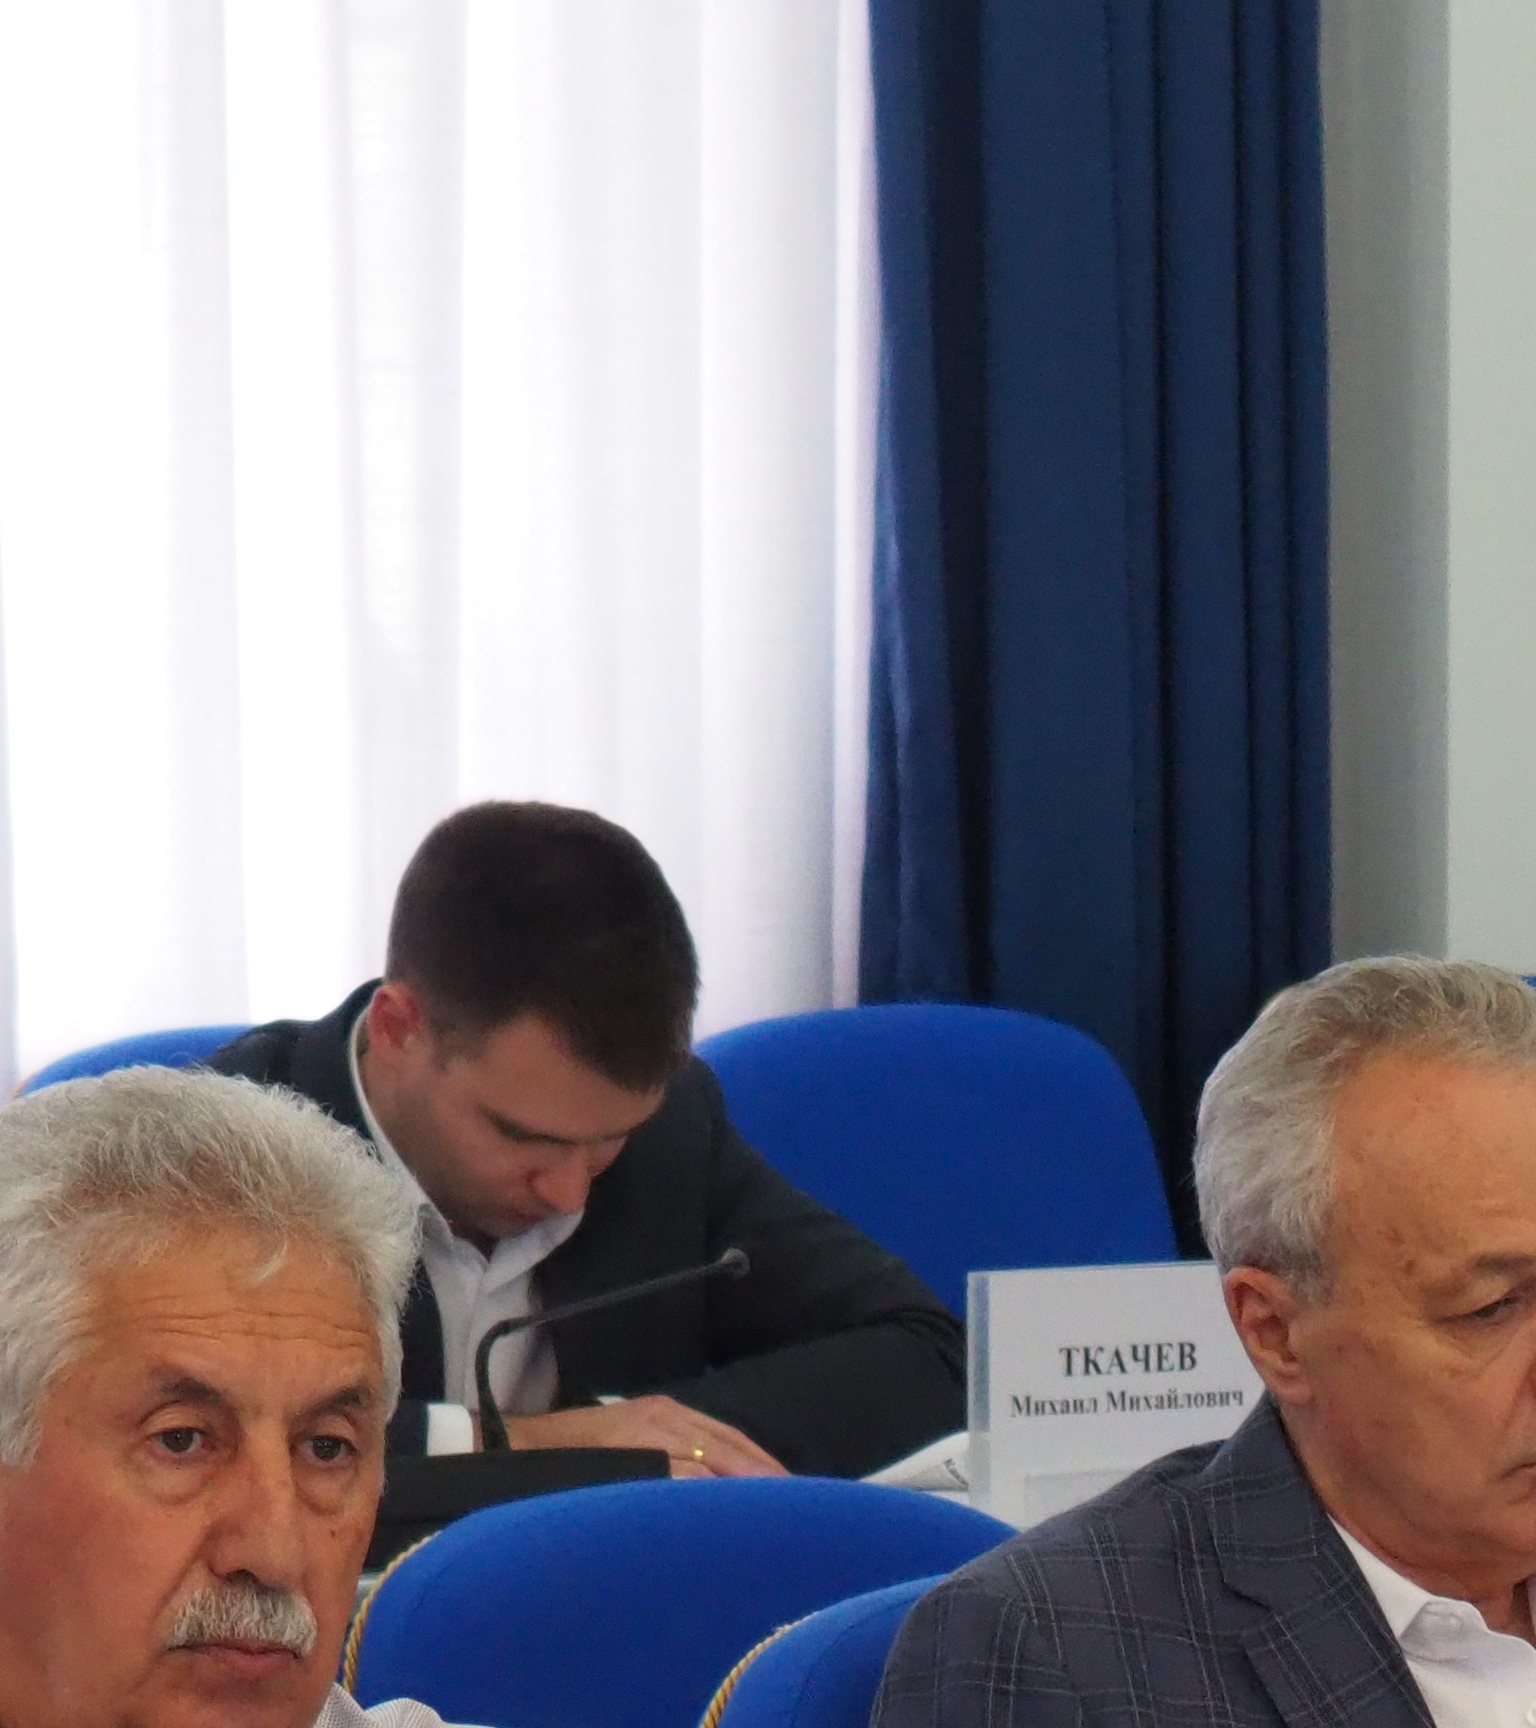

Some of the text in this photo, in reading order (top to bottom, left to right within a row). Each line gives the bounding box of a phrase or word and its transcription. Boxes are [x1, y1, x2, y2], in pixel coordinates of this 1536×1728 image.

[1058, 1341, 1198, 1378] ТКАЧЕВ
[1010, 1387, 1245, 1418] Михаил Михайлович
